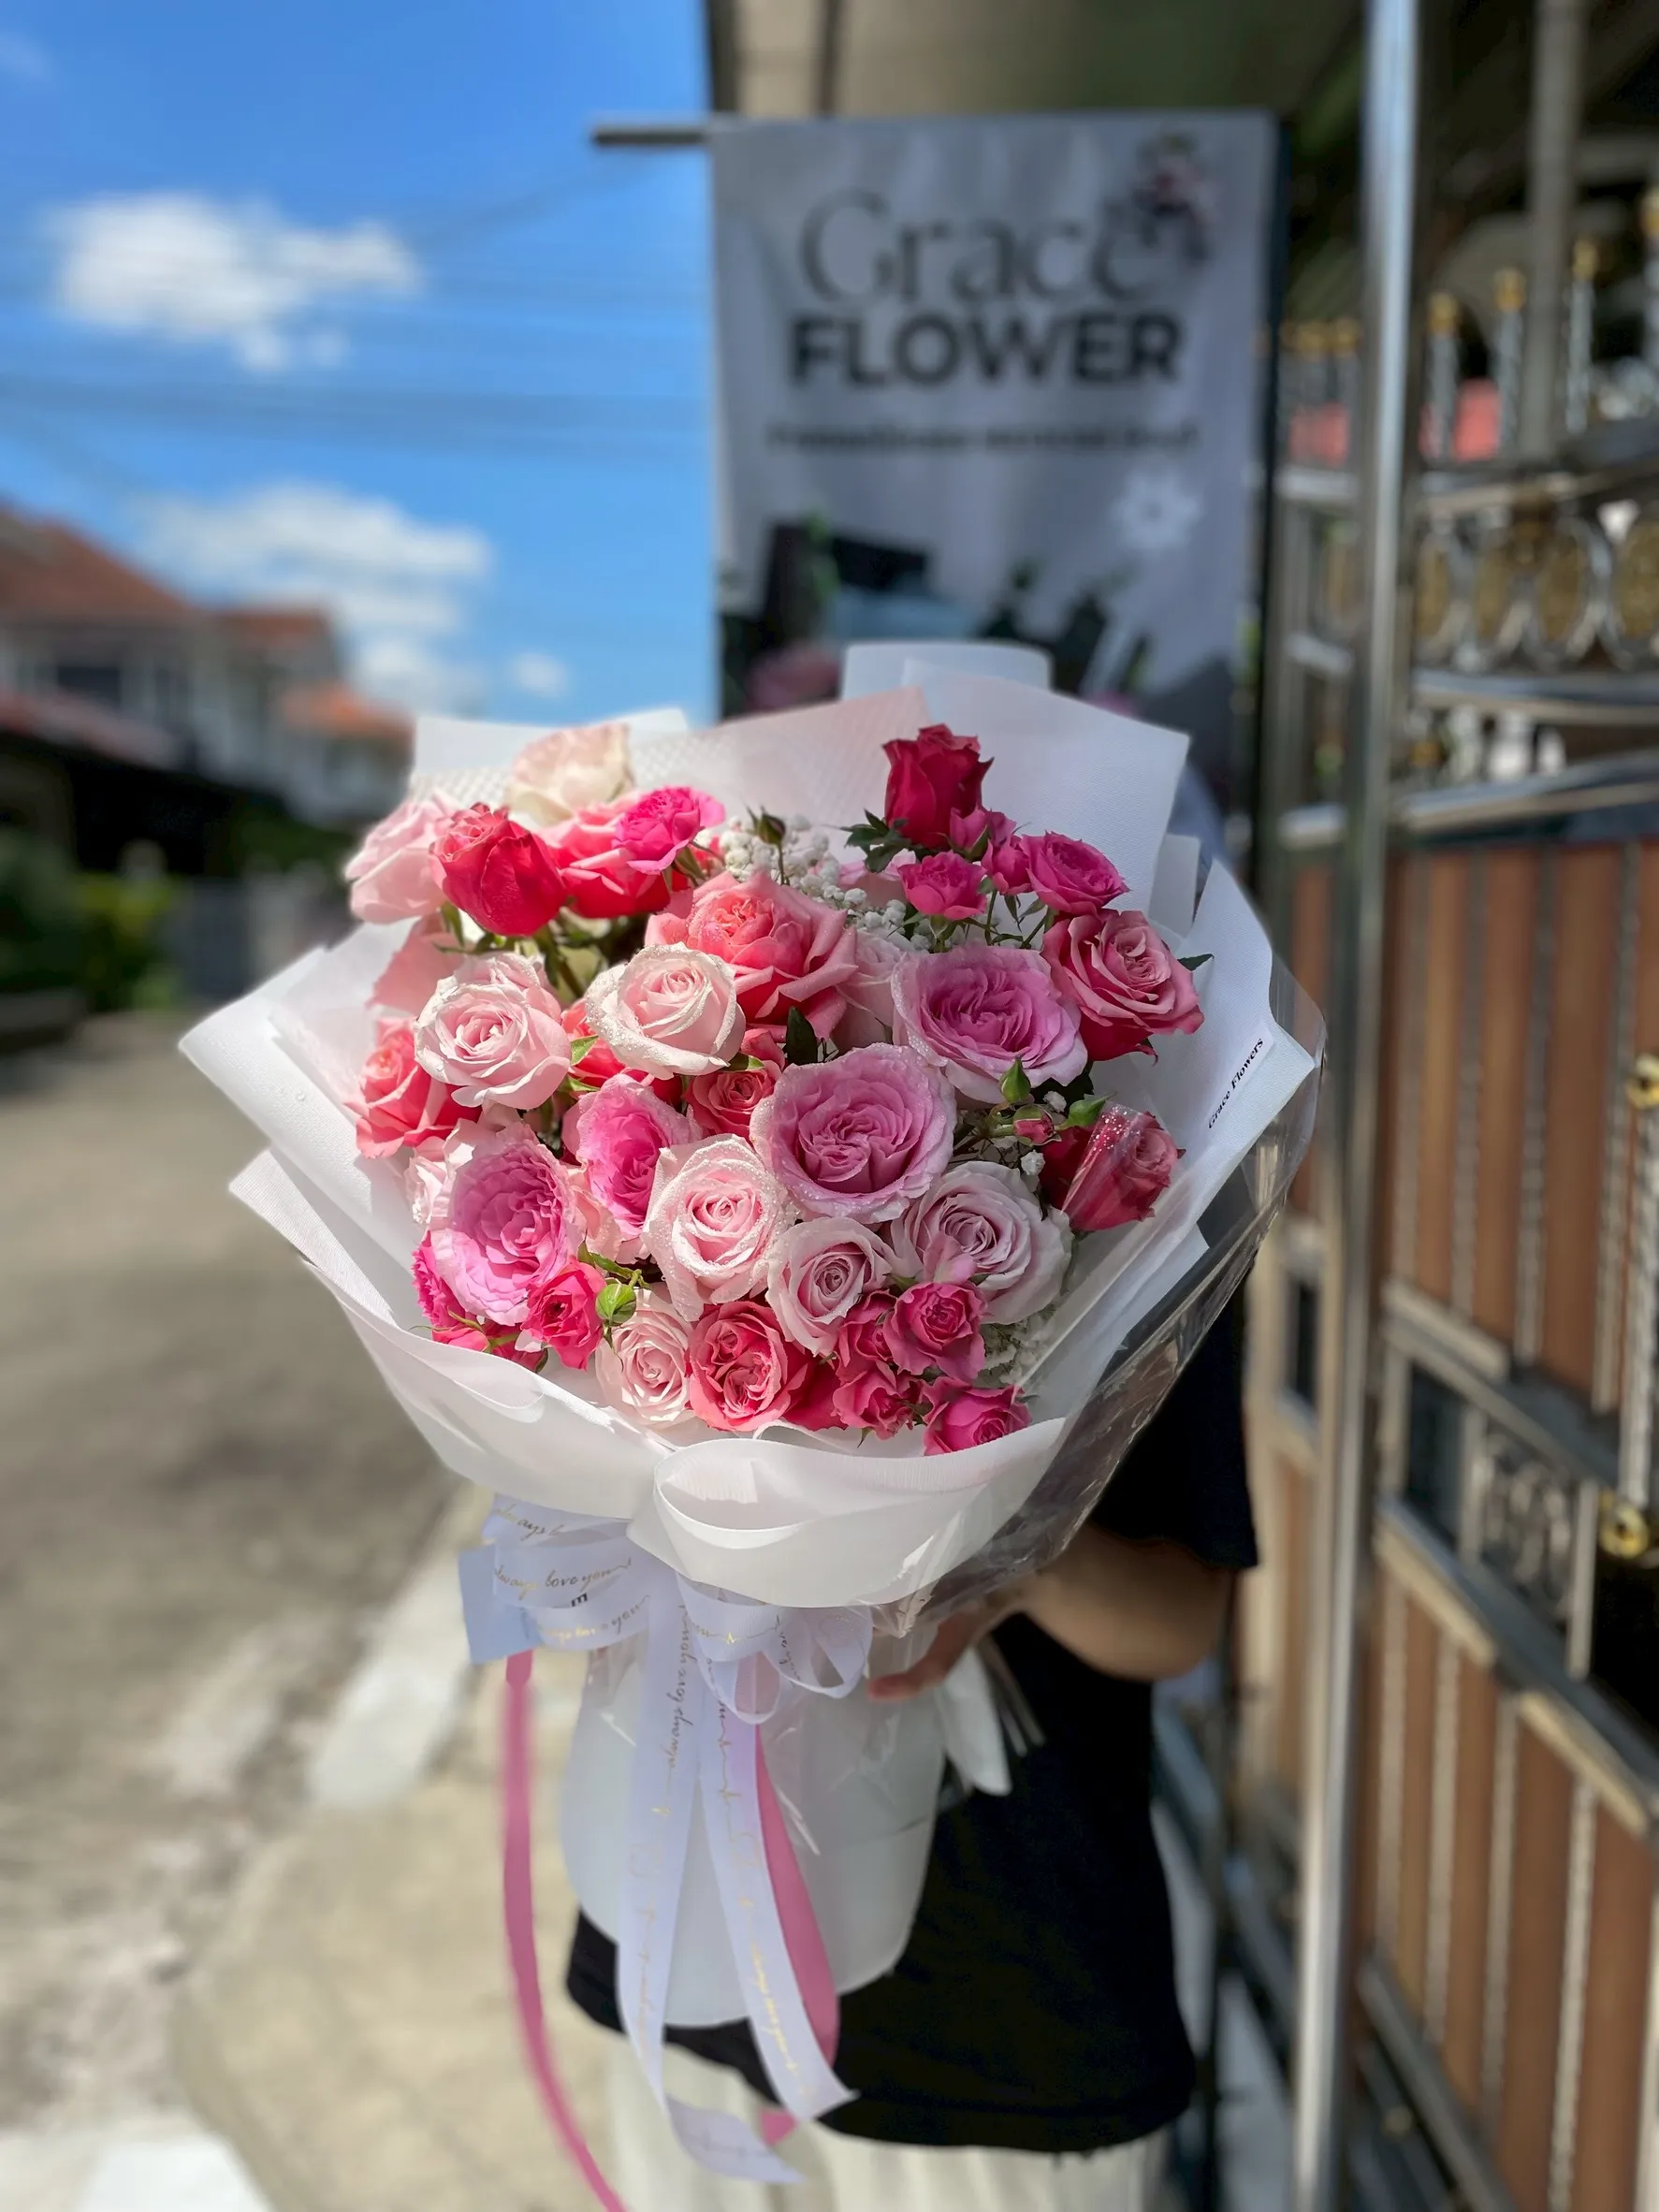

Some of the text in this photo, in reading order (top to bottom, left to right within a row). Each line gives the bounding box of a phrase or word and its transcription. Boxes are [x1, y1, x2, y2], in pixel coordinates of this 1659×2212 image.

[800, 187, 1166, 305] Grace
[790, 313, 1183, 386] FLOWER
[1208, 1038, 1264, 1129] Grace Flowers
[546, 1569, 578, 1587] love
[666, 1668, 687, 1703] love
